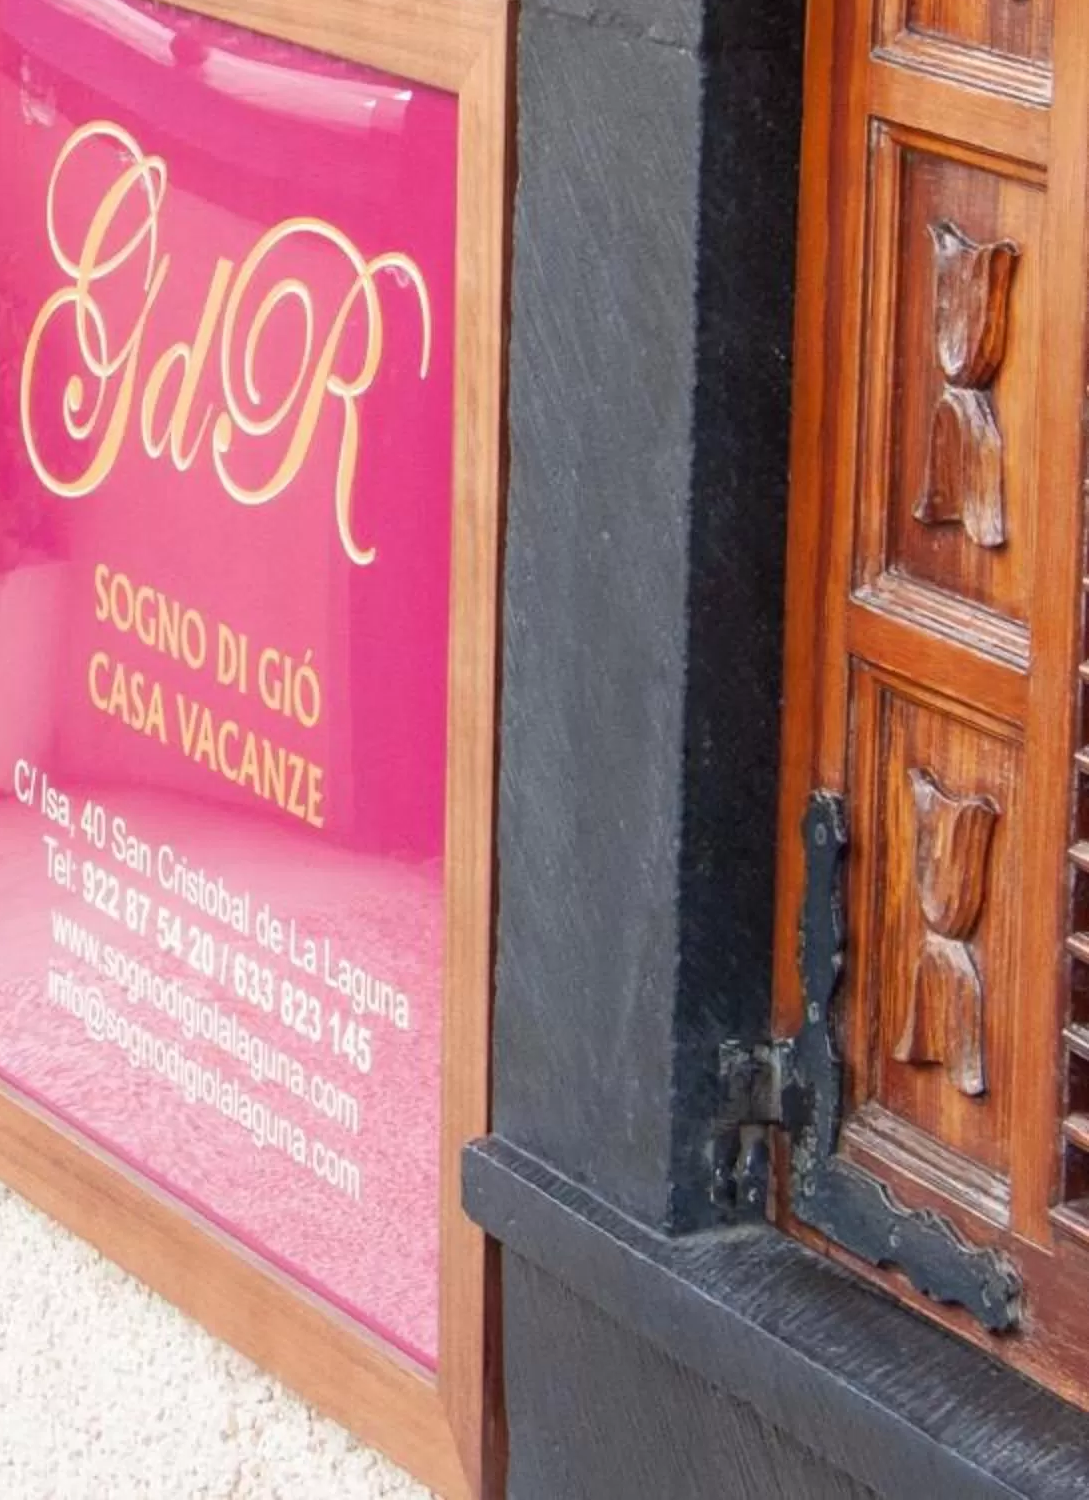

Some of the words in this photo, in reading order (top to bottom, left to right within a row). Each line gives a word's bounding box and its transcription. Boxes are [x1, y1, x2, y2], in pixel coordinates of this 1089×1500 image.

[88, 651, 167, 744] CASA
[176, 693, 324, 828] VACANZE
[95, 563, 206, 669] SOGNO
[217, 622, 248, 693] DI
[258, 648, 321, 728] GIÓ
[14, 759, 37, 806] C/
[41, 773, 76, 838] Isa,
[80, 799, 106, 849] 40
[111, 816, 151, 877] San
[158, 845, 250, 937] Cristobal
[256, 903, 284, 954] de
[290, 918, 317, 974] La
[324, 936, 409, 1029] Laguna
[42, 834, 77, 893] Tel:
[83, 860, 120, 920] 922
[126, 888, 151, 936] 87
[157, 906, 183, 956] 54
[188, 926, 214, 977] 20
[234, 952, 274, 1012] 633
[281, 980, 322, 1042] 823
[329, 1011, 372, 1073] 145
[51, 909, 359, 1135] www.sognodigiolalaguna.com
